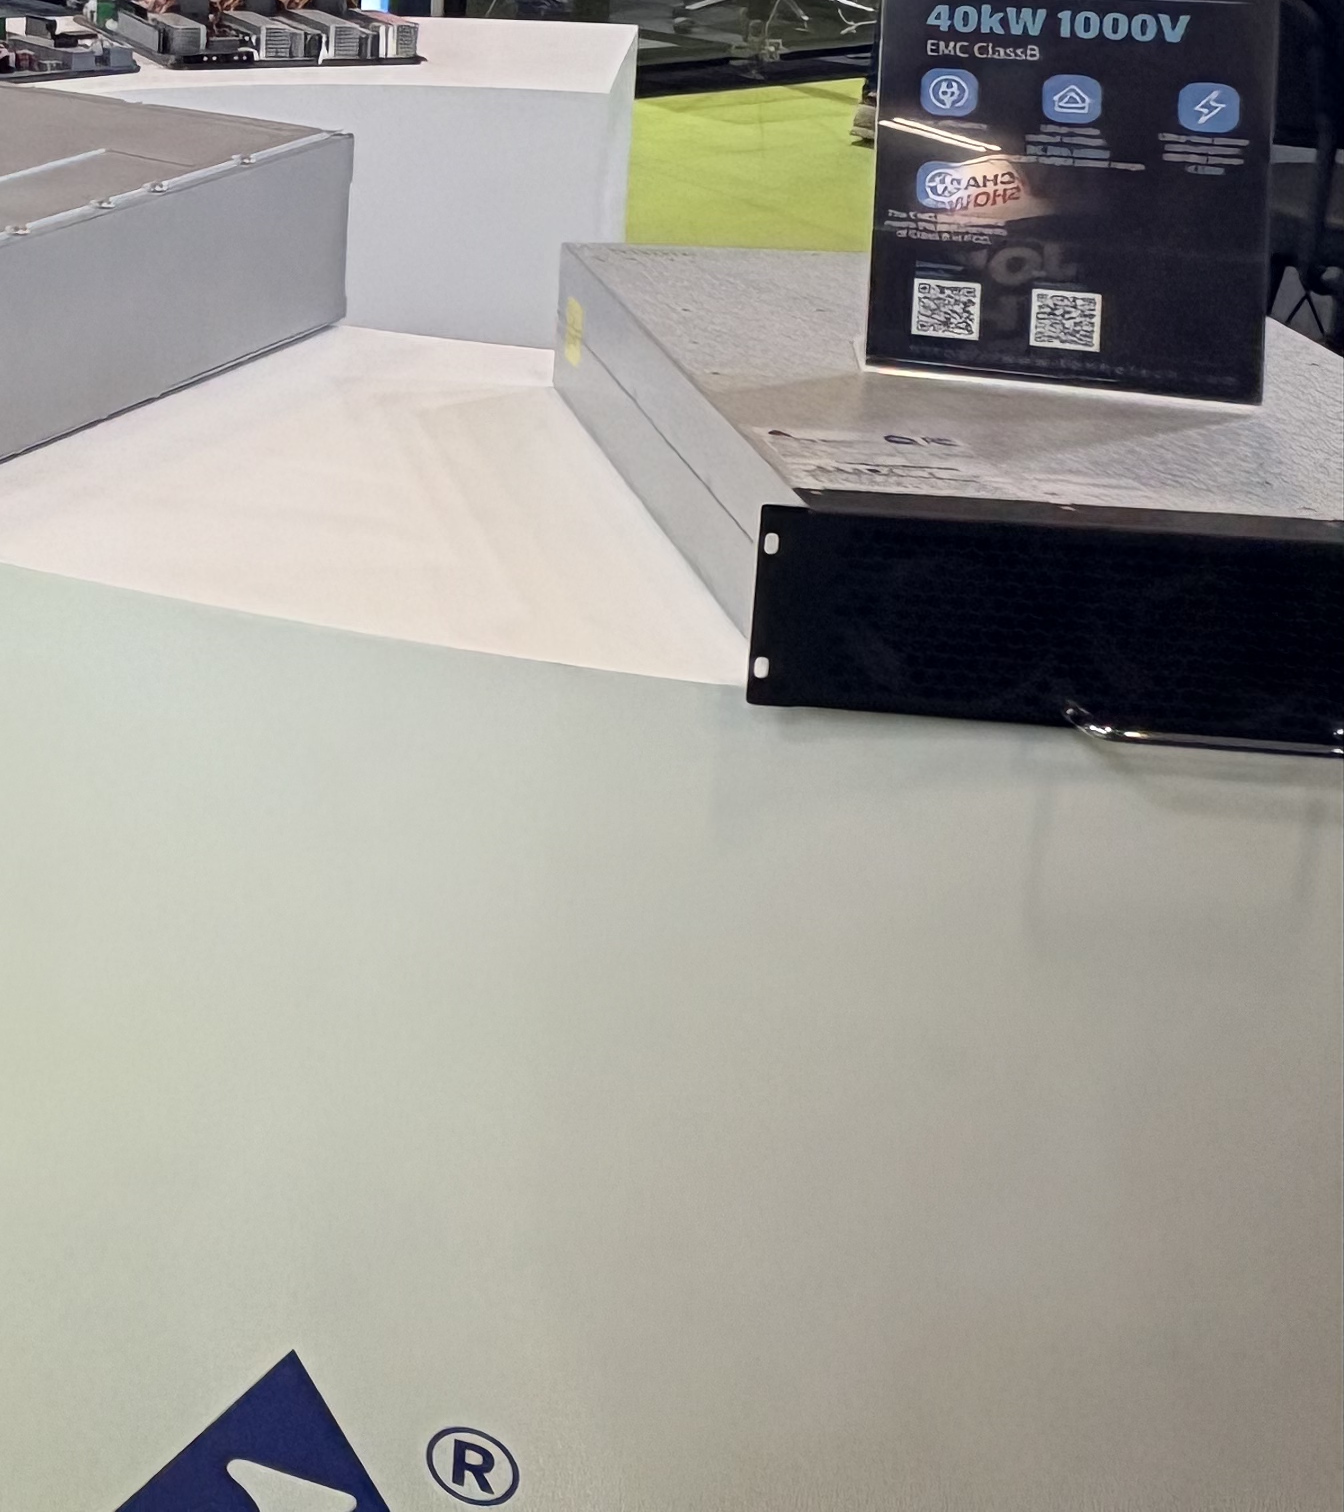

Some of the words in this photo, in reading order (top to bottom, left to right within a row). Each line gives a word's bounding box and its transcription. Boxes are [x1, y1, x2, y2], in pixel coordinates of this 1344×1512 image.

[926, 4, 1047, 37] 40kW
[1057, 10, 1191, 43] 1000V
[926, 40, 970, 58] EMC
